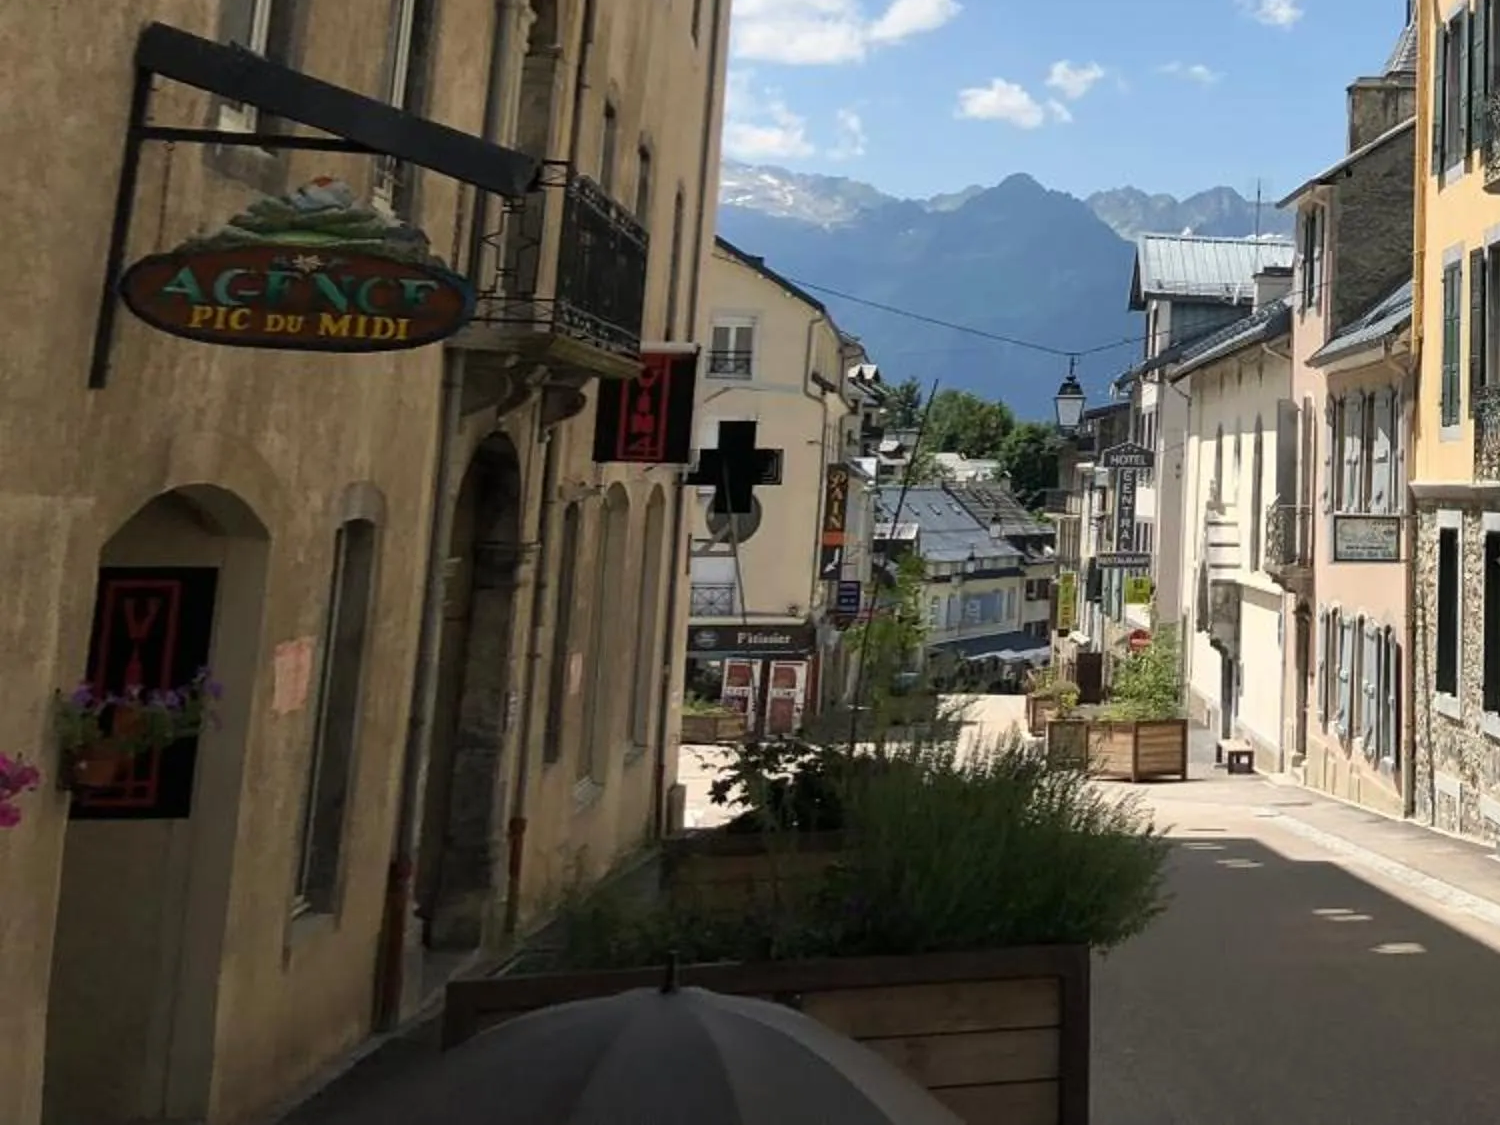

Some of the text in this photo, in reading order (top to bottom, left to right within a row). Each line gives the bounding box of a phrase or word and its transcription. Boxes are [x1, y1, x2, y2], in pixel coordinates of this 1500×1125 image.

[162, 266, 438, 312] AGENCE
[188, 305, 413, 341] PIC DU MIDI
[1110, 455, 1147, 466] HOTEL
[828, 469, 847, 529] PAIN
[1120, 469, 1133, 552] CENTRAL
